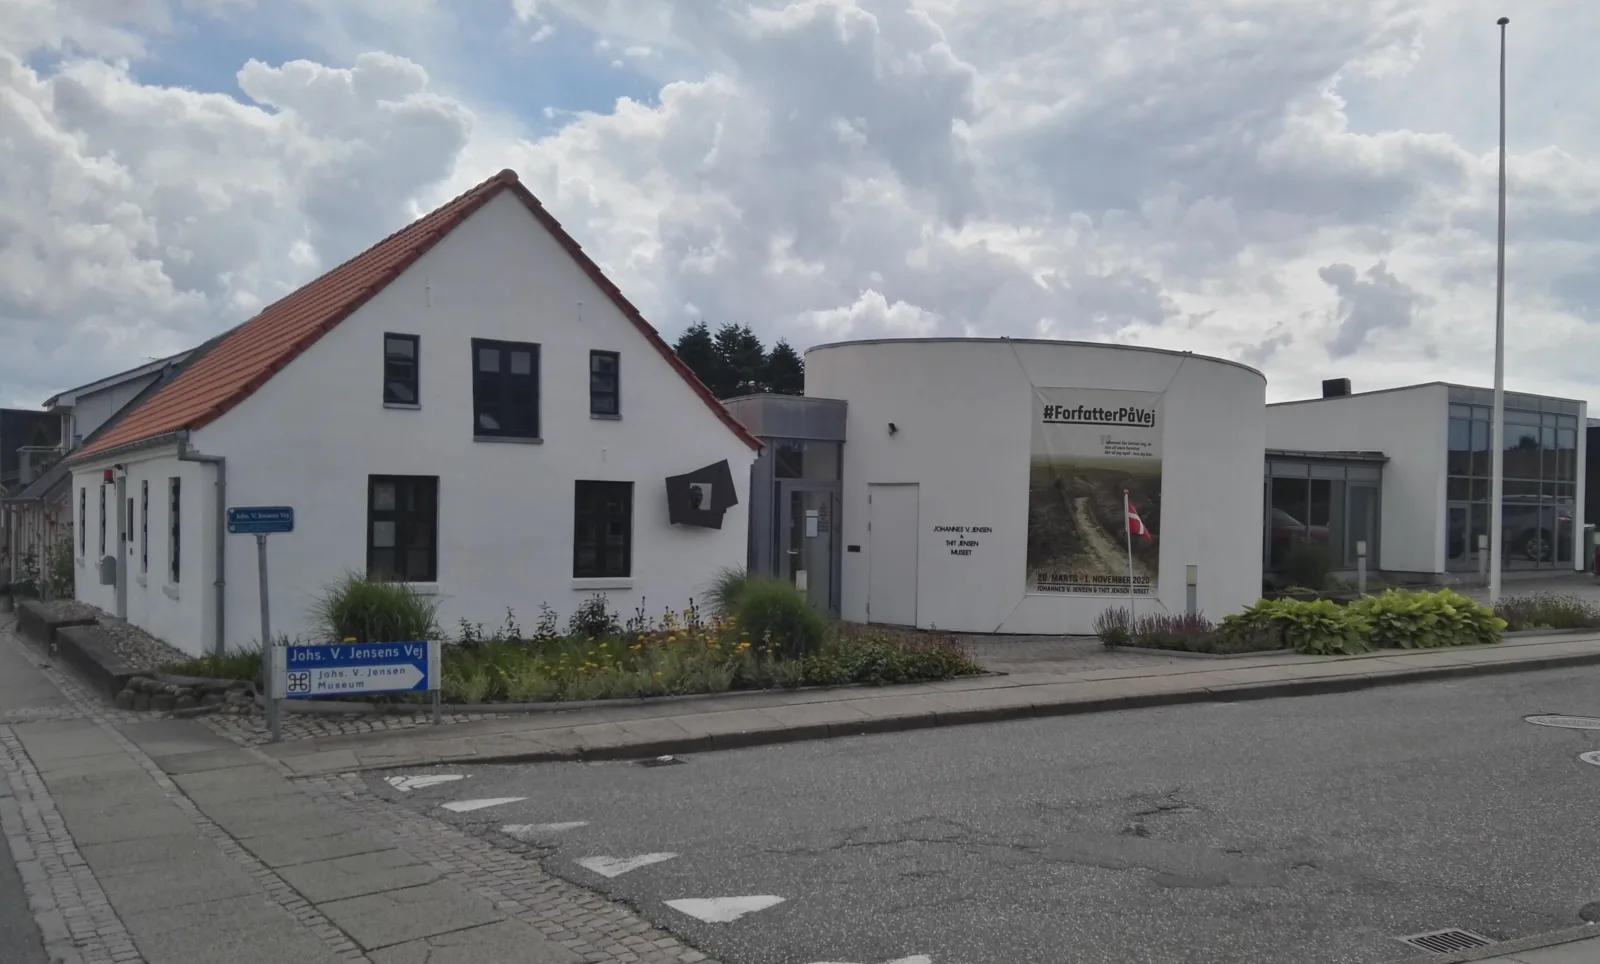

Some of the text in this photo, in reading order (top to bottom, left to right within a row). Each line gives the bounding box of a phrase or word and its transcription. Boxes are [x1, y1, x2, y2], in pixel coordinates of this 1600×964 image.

[1043, 404, 1155, 428] #ForfatterPåVej
[933, 525, 964, 533] JOHANNES
[1051, 574, 1078, 583] MARTS
[1092, 575, 1131, 585] NOVEMBER
[1132, 576, 1150, 585] 2020
[291, 645, 423, 662] Johs. V. Jensens Vej
[318, 667, 406, 680] Johs. V. Jensen
[318, 680, 364, 690] Museum
